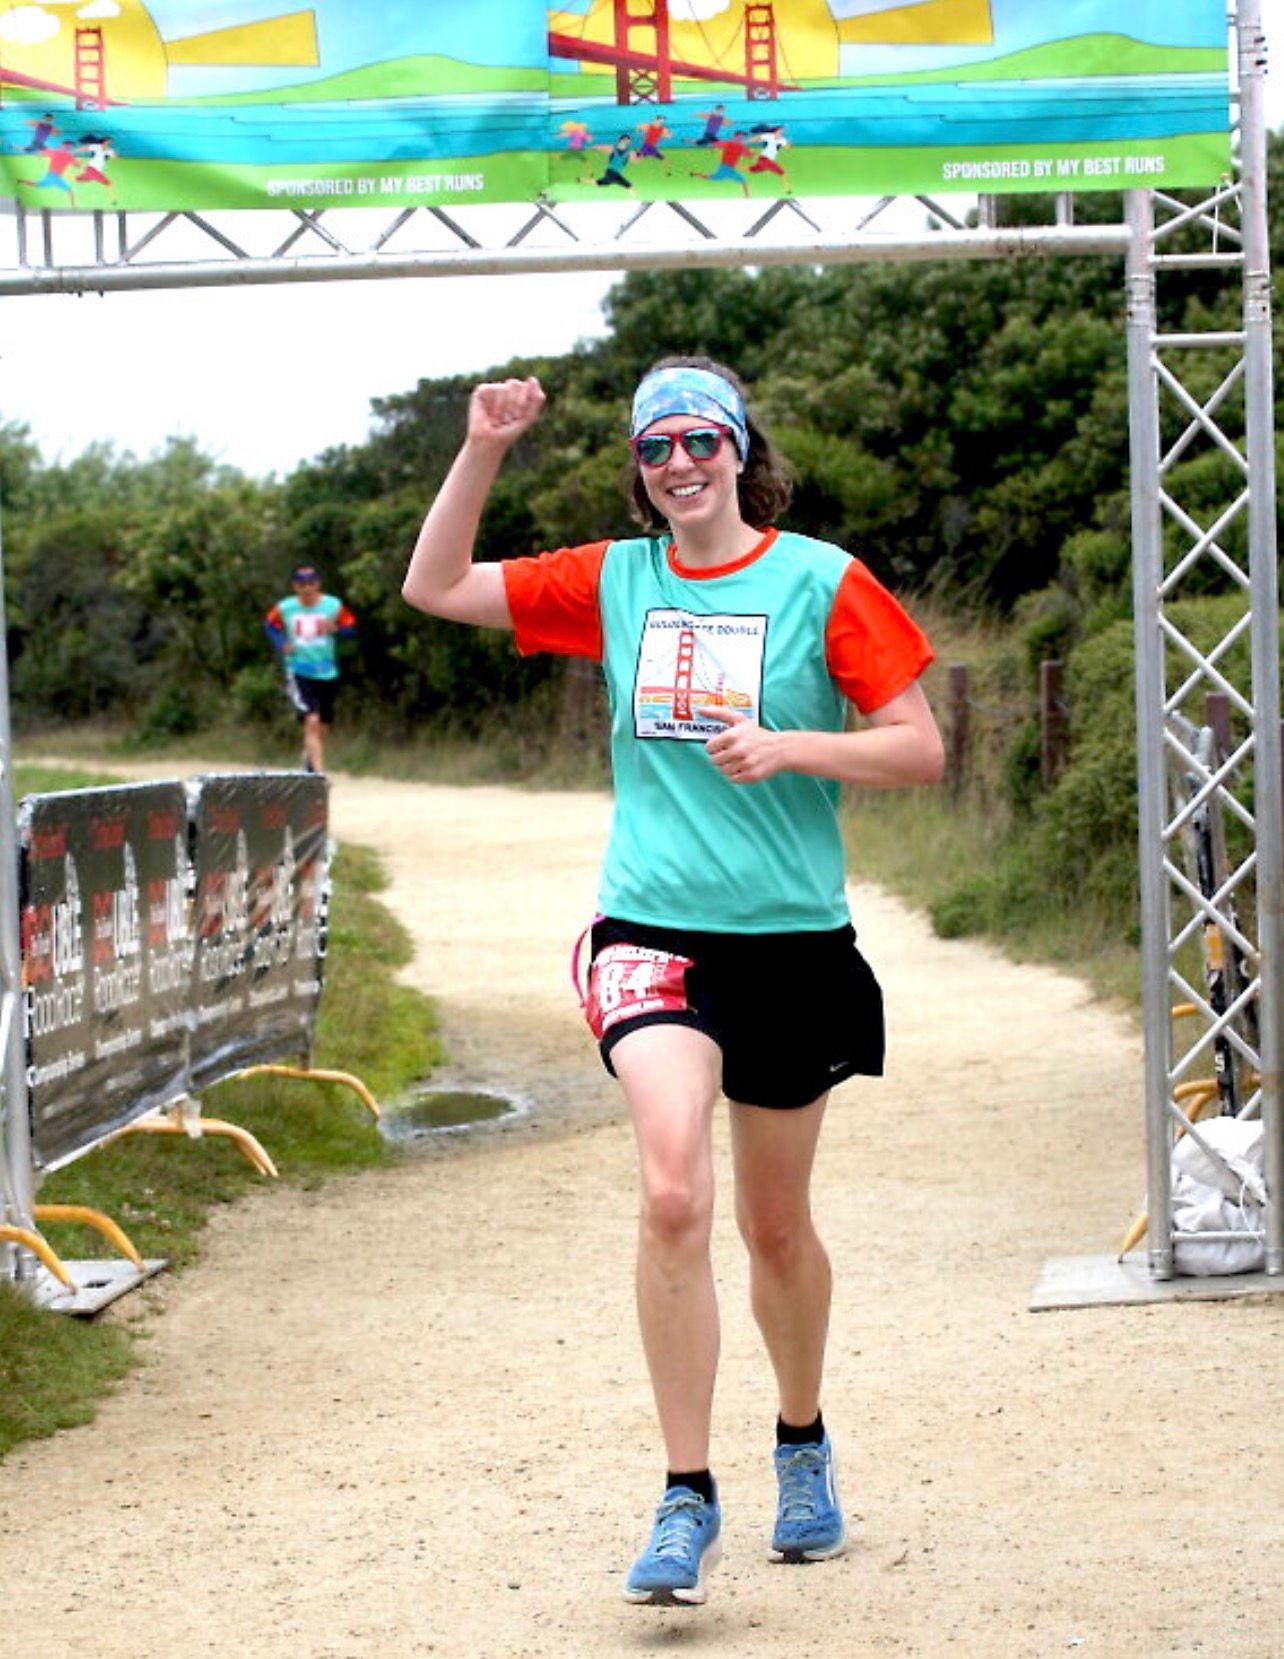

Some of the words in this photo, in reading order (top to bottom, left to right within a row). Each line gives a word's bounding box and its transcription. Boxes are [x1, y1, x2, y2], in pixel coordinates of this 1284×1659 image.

[942, 161, 1030, 180] SPONSORED
[1034, 160, 1053, 176] BY
[1057, 159, 1080, 176] MY
[1084, 157, 1121, 175] BEST
[1124, 155, 1165, 174] RUNS
[267, 178, 353, 197] SPONSORED
[358, 177, 376, 194] BY
[380, 176, 402, 193] MY
[407, 174, 442, 193] BEST
[444, 173, 485, 192] RUNS
[678, 722, 729, 734] FRANCIS
